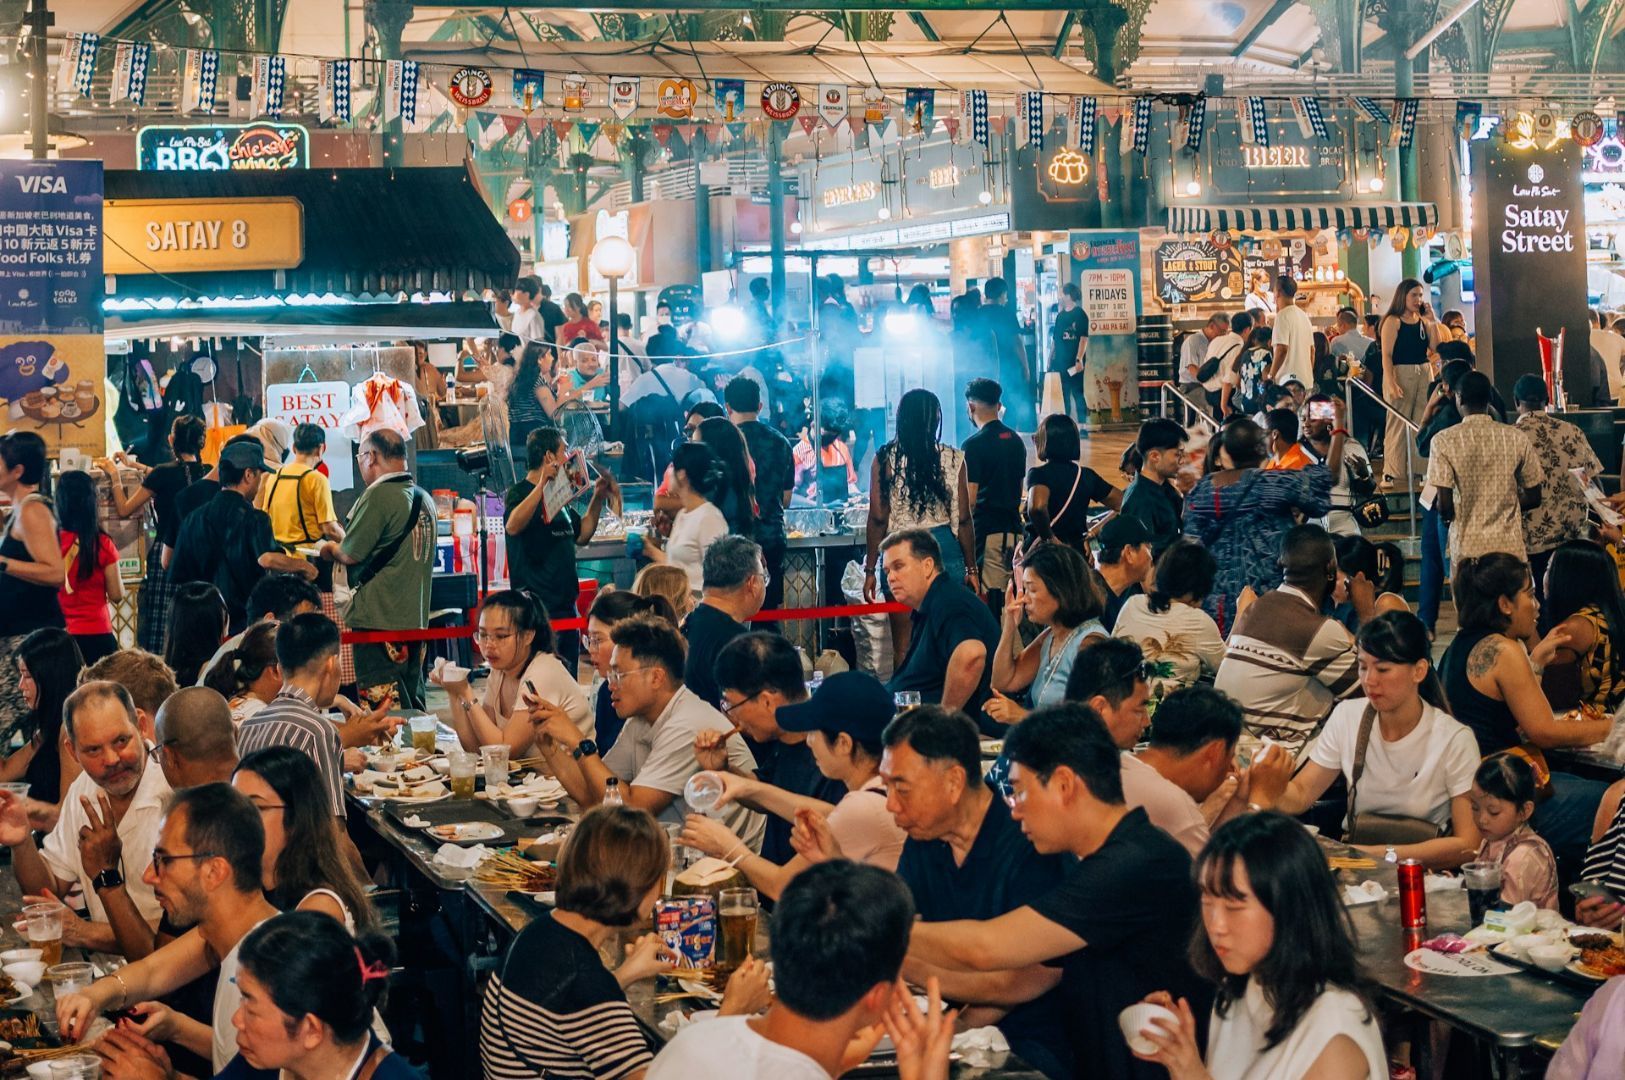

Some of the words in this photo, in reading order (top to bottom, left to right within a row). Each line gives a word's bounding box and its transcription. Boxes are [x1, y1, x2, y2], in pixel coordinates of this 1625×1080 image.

[453, 68, 490, 86] ERDINGER
[764, 82, 798, 99] ERDINGER
[1572, 113, 1602, 128] ERDINGER
[156, 141, 230, 170] BBQ
[1244, 146, 1310, 168] BEER
[1320, 146, 1342, 154] LOCAL
[1320, 158, 1342, 166] BREW
[15, 176, 68, 194] VISA
[517, 208, 524, 218] 4
[1505, 204, 1570, 233] Satay
[0, 224, 54, 237] 中国大陆
[56, 225, 84, 236] Visa
[85, 224, 98, 237] 卡
[146, 220, 222, 251] SATAY
[232, 219, 246, 249] 8
[4, 239, 19, 250] 10
[21, 238, 58, 250] 新元返
[61, 240, 68, 250] 5
[70, 239, 96, 250] 新元
[1502, 230, 1574, 252] Street
[0, 252, 26, 264] ood
[30, 252, 64, 264] Folks
[66, 252, 92, 264] 礼券
[1162, 260, 1186, 272] LAGER
[1194, 260, 1218, 271] STOUT
[1088, 274, 1102, 282] 7PM
[1110, 273, 1126, 282] 10PM
[1089, 288, 1127, 300] FRIDAYS
[1099, 322, 1110, 330] LAU
[282, 393, 336, 411] BEST
[275, 412, 344, 428] ATAY
[684, 933, 712, 950] Tiger
